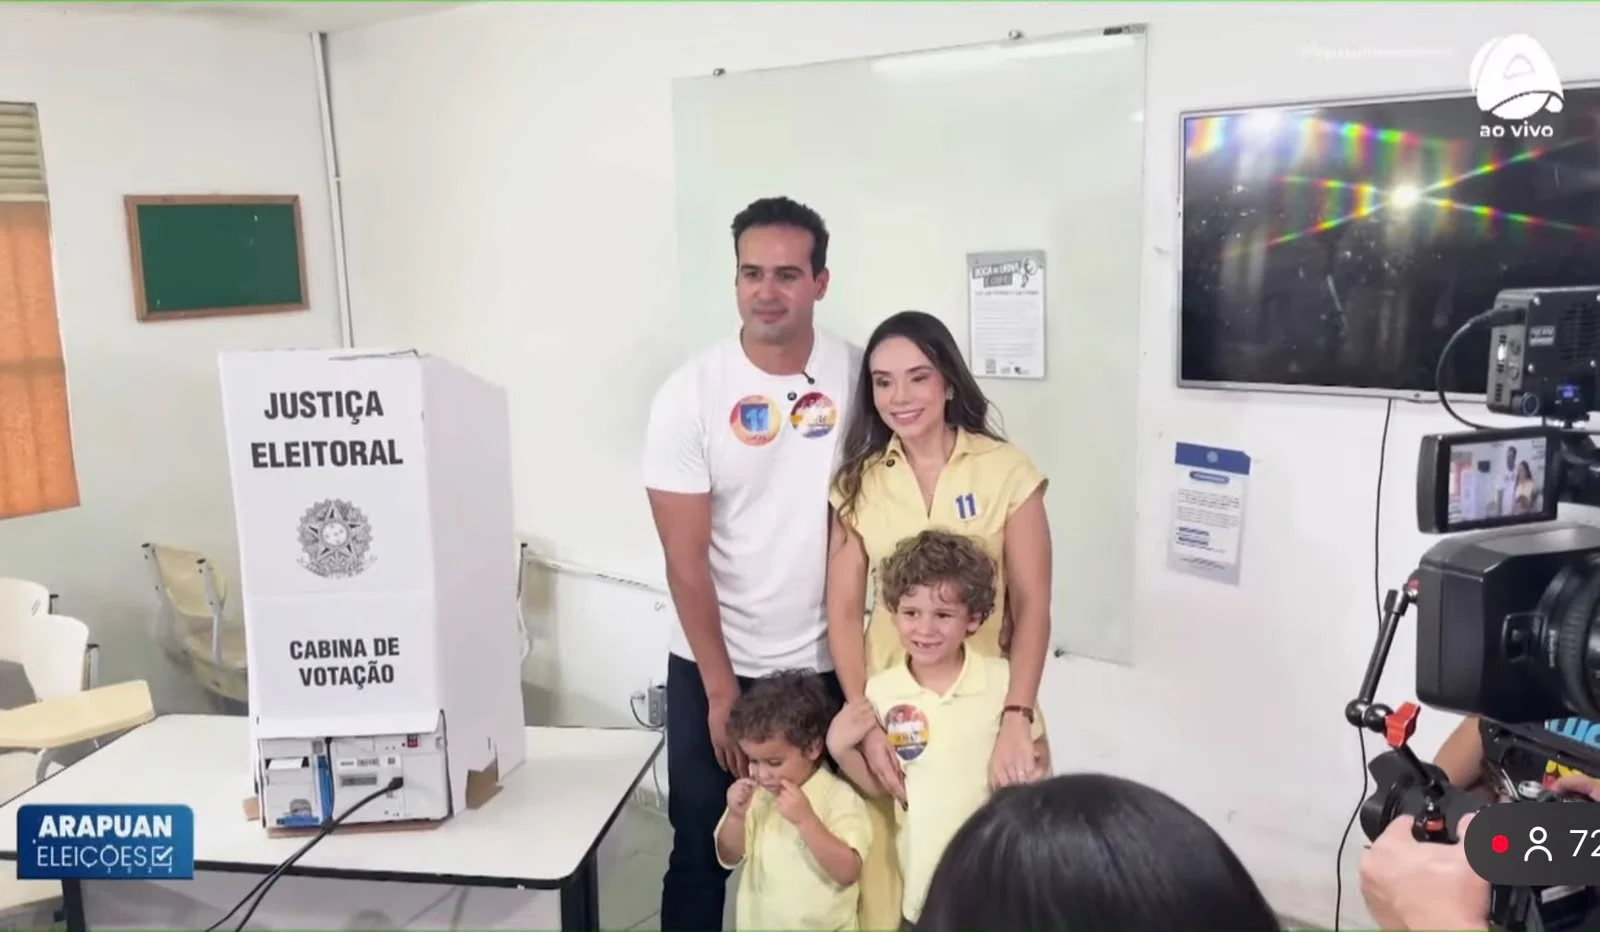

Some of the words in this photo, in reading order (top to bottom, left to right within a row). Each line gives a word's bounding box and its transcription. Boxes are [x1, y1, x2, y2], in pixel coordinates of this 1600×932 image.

[264, 390, 385, 425] JUSTIÇA
[746, 407, 769, 433] 11
[250, 439, 404, 468] ELEITORAL
[955, 493, 977, 519] 11
[289, 638, 368, 660] CABINA
[373, 637, 400, 657] DE
[298, 660, 394, 690] VOTAÇÃO
